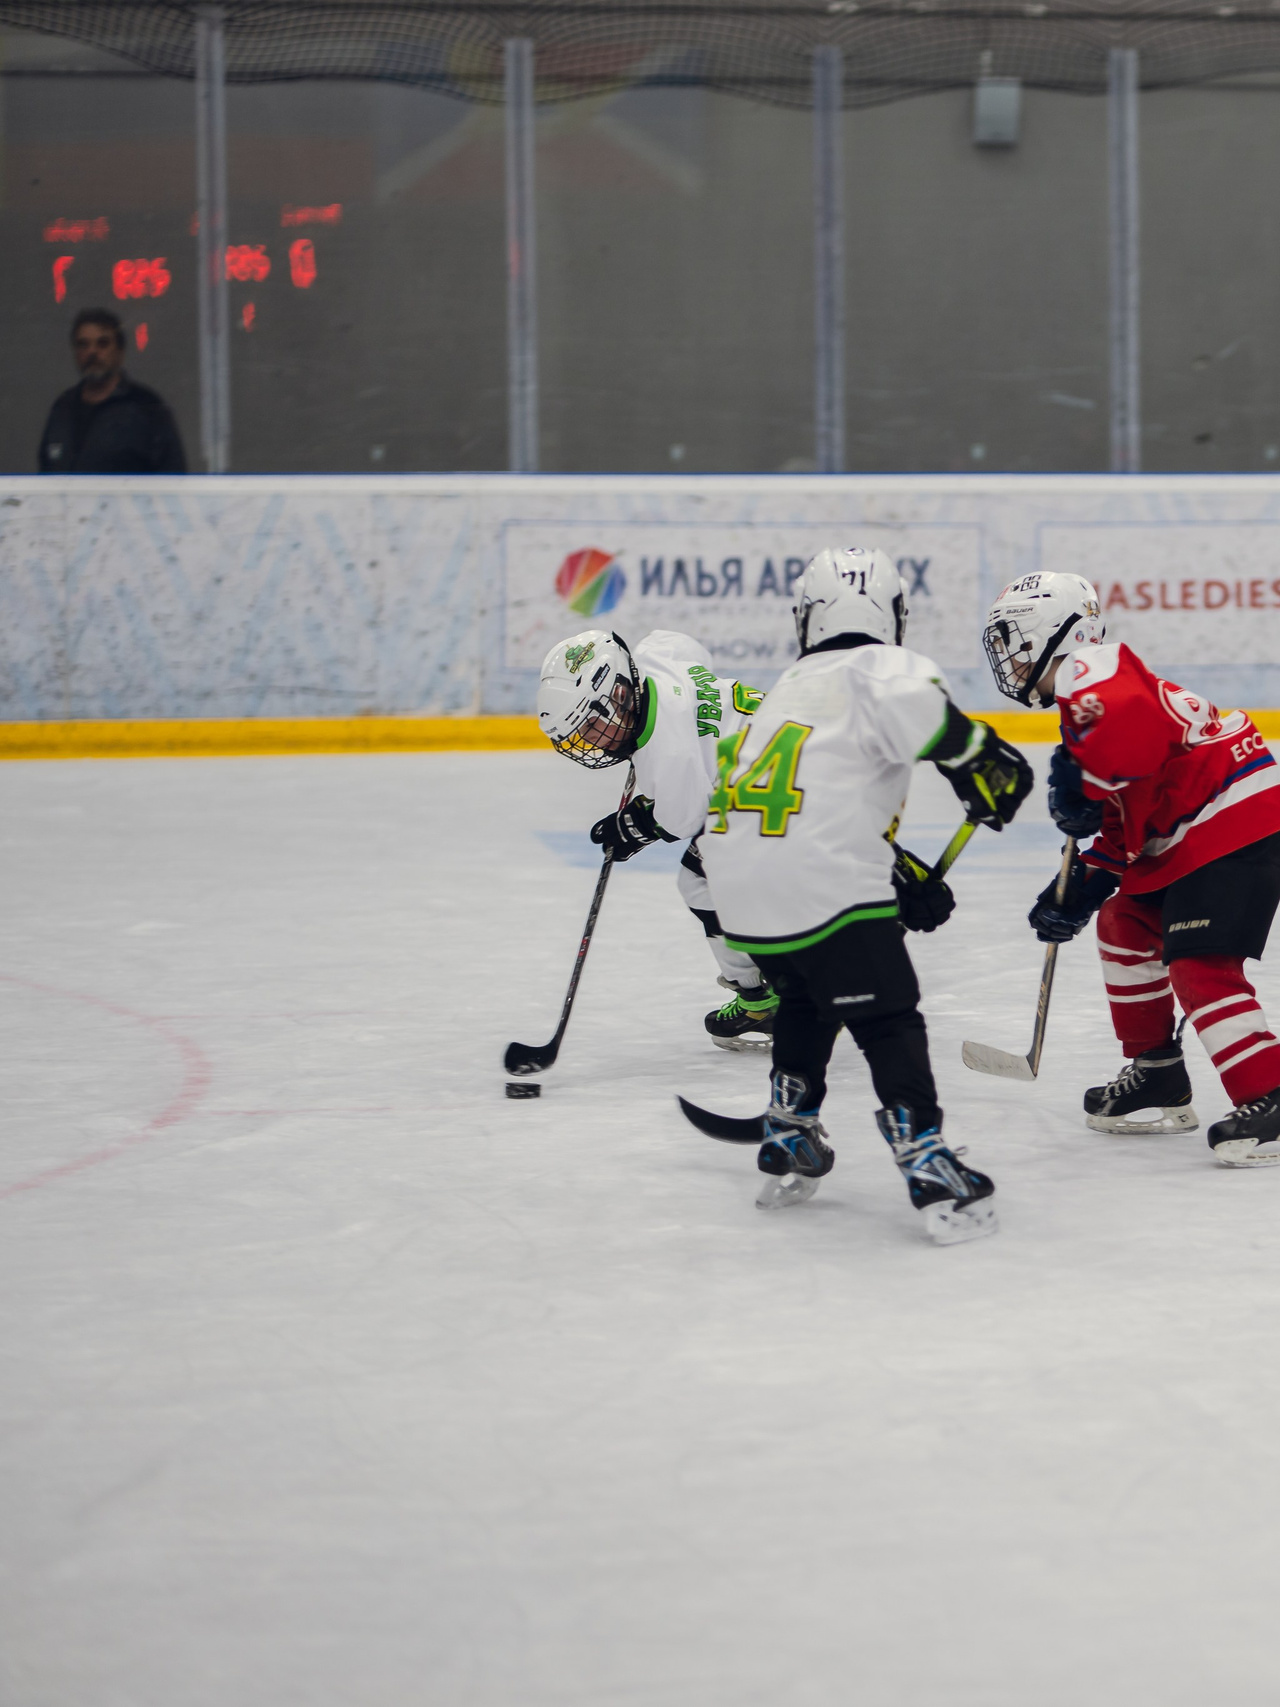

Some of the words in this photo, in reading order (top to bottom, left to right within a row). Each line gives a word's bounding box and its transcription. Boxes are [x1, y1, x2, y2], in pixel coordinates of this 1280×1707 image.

[640, 557, 743, 597] ИЛЬЯ
[841, 571, 867, 596] 71
[708, 720, 814, 837] 44
